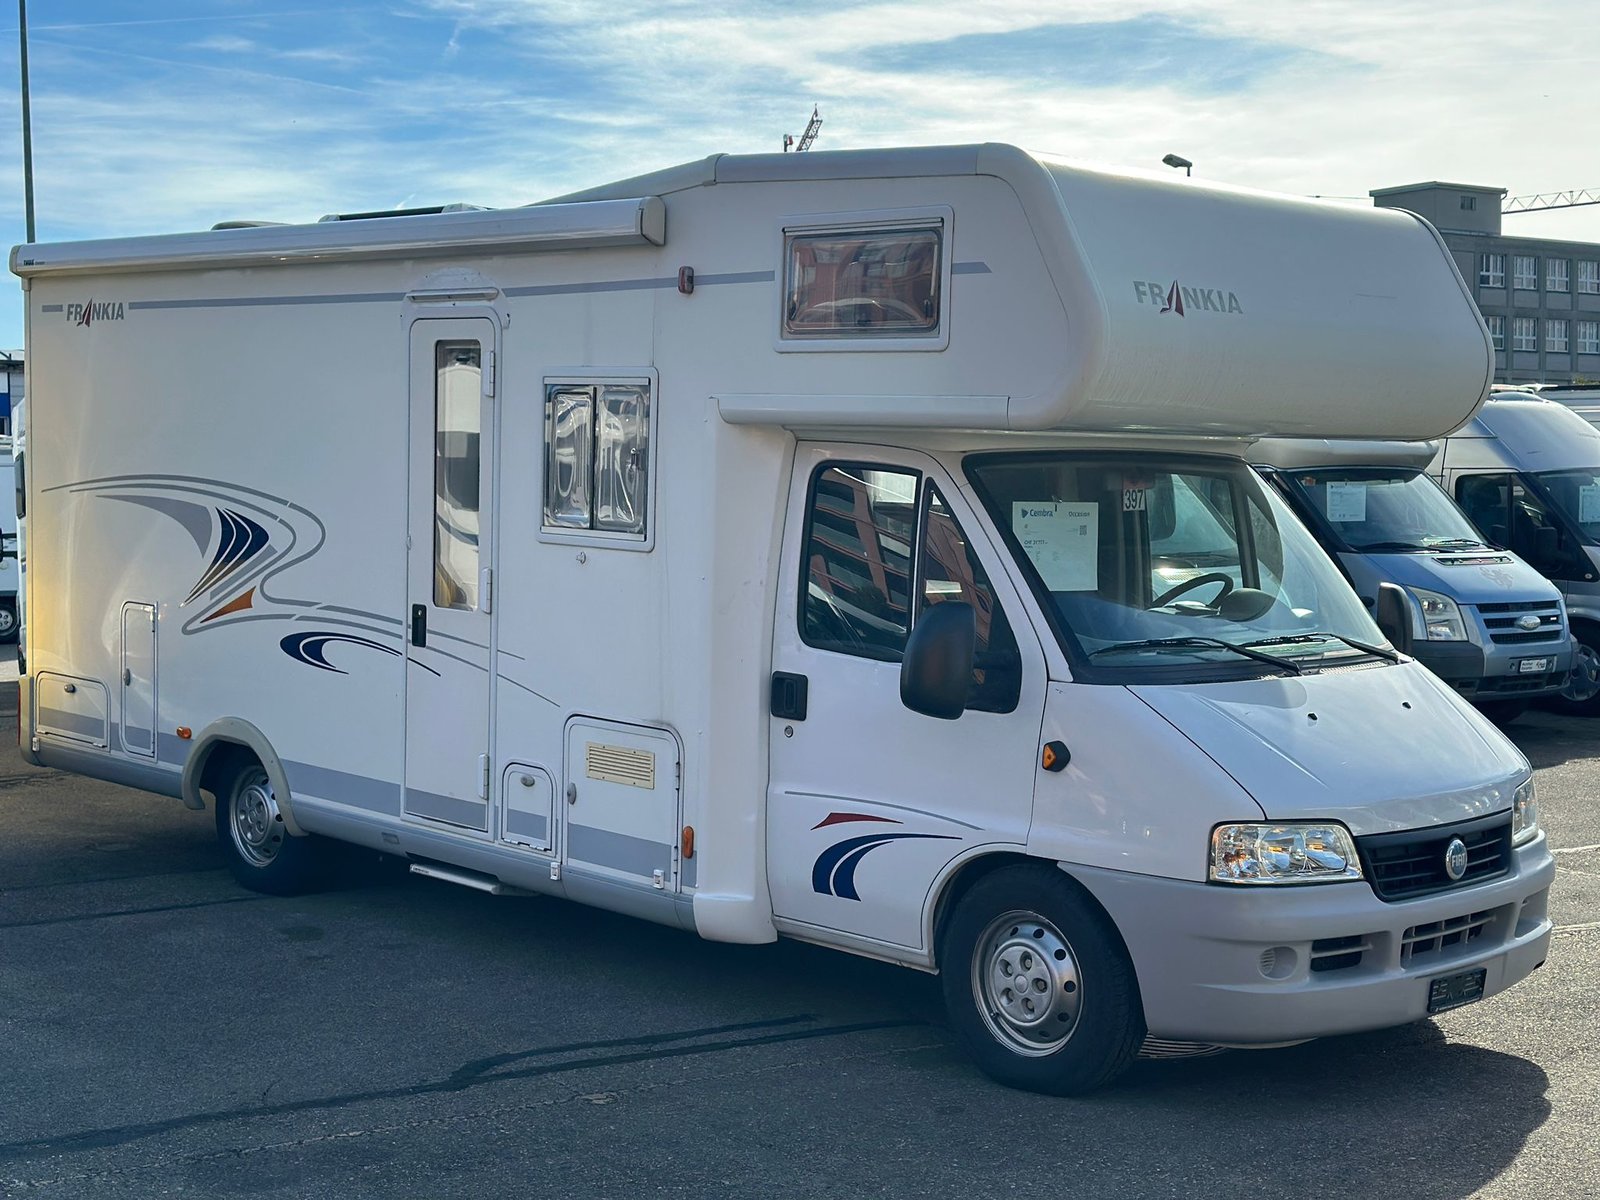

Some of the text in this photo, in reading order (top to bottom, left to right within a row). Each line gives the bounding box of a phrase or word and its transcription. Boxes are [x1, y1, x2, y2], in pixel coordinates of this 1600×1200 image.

[1132, 280, 1244, 317] FRANKIA
[66, 299, 124, 327] FRANKIA
[1124, 489, 1144, 509] 397
[1029, 508, 1053, 517] Cembra
[1451, 853, 1465, 867] FIAT
